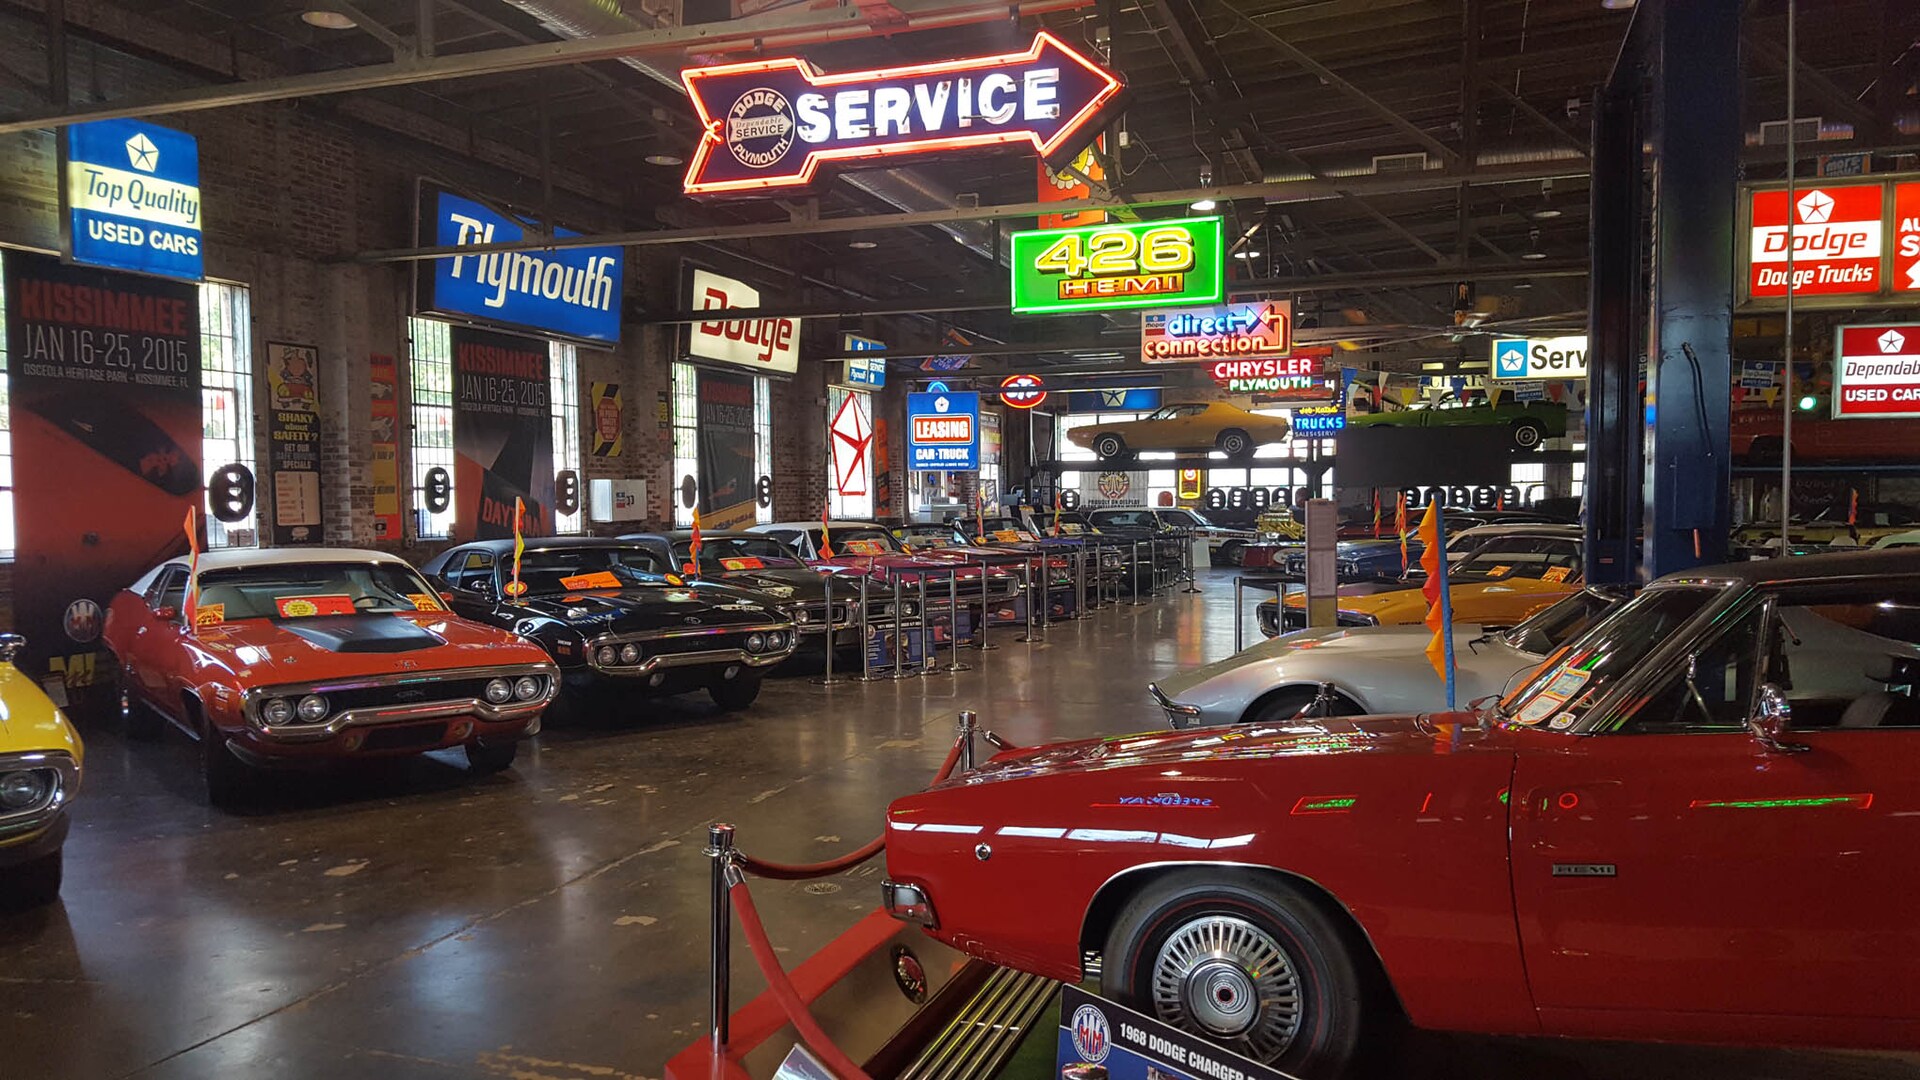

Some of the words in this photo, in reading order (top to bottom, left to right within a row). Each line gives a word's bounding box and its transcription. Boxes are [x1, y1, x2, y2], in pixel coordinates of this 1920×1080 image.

[734, 92, 785, 118] DODGE
[796, 68, 1060, 143] SERVICE
[736, 116, 782, 129] Dependable
[736, 124, 784, 138] SERVICE
[733, 138, 789, 165] PLYMOUTH
[84, 169, 123, 208] Top
[128, 179, 198, 224] Quality
[88, 219, 144, 246] USED
[149, 230, 199, 256] CARS
[1763, 227, 1867, 257] Dodge
[451, 213, 616, 311] Plymouth
[1034, 227, 1194, 277] 426
[1062, 276, 1178, 295] HEMI
[1817, 263, 1874, 284] Trucks
[20, 278, 188, 336] KISSIMMEE
[1168, 311, 1240, 337] direct
[23, 323, 64, 362] JAN
[71, 329, 136, 371] 16-25,
[142, 337, 188, 373] 2015
[1144, 334, 1266, 358] connection
[1531, 344, 1587, 370] Serv
[23, 363, 64, 378] OSCEOLA
[66, 366, 105, 381] HERITAGE
[106, 370, 129, 383] PARK
[458, 341, 544, 381] KISSIMMEE
[1215, 359, 1311, 378] CHRYSLER
[461, 374, 482, 400] JAN
[520, 381, 545, 406] 2015
[1229, 376, 1312, 391] PLYMOUTH
[1845, 388, 1888, 402] USED
[278, 412, 313, 423] SHAKY
[915, 421, 969, 439] LEASING
[1295, 416, 1343, 430] TRUCKS
[1554, 865, 1615, 875] HEMI
[1120, 1022, 1147, 1047] 1968
[1149, 1034, 1187, 1064] DODGE
[1188, 1051, 1244, 1080] CHARGER
